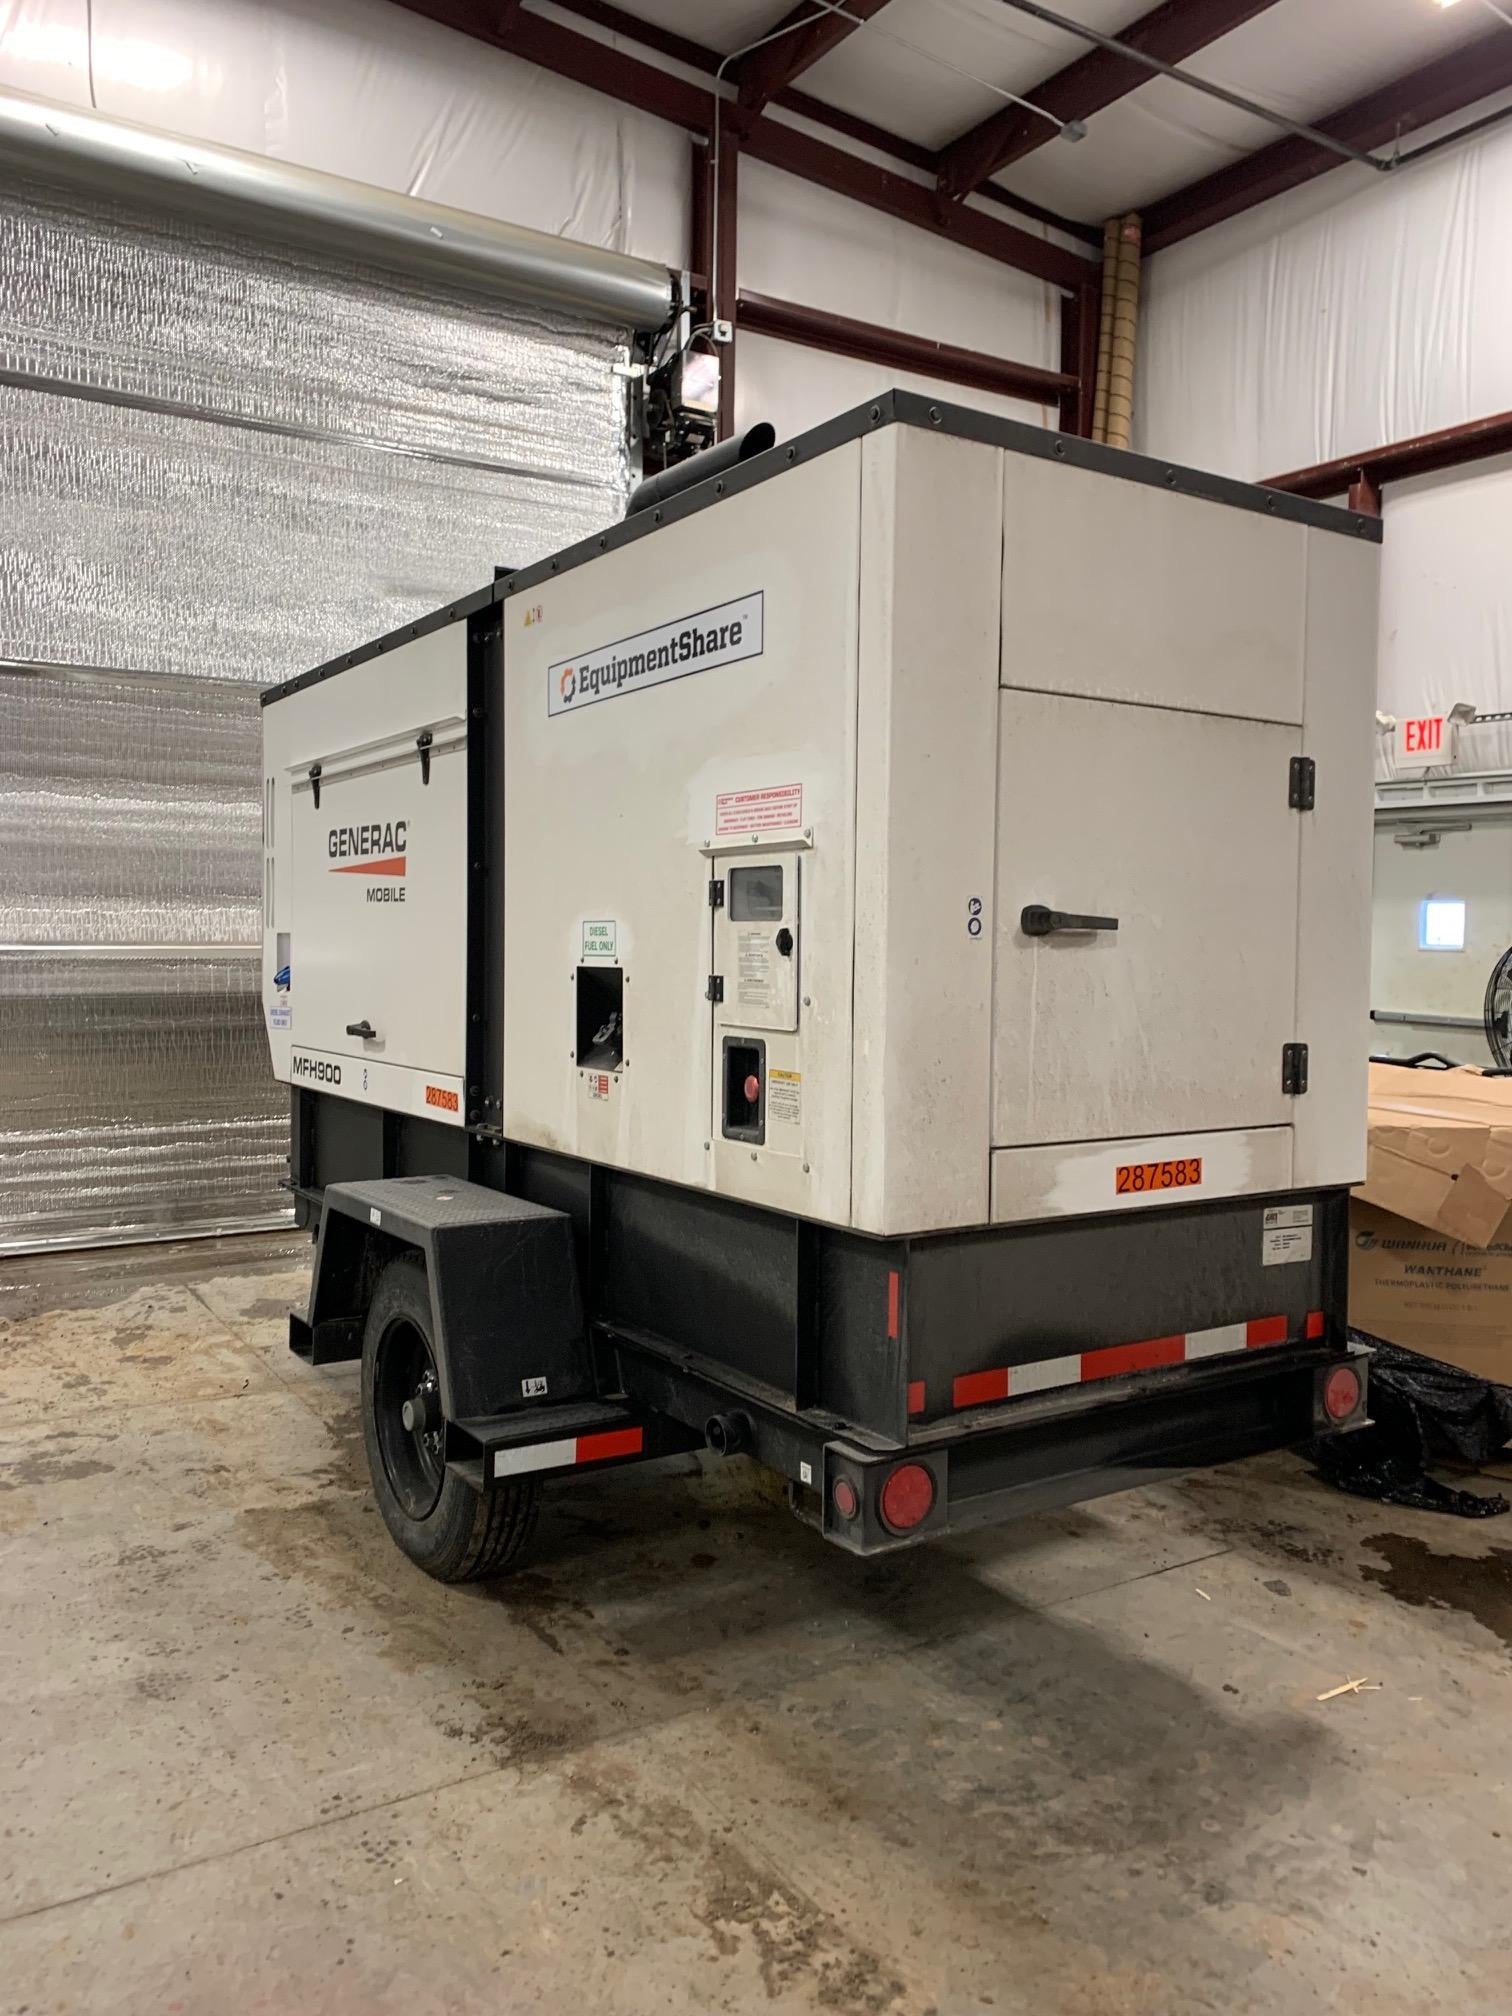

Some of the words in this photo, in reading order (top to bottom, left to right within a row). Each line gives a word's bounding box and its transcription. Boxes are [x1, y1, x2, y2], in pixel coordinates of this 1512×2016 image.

[579, 621, 742, 695] EquipmentShare
[1406, 719, 1443, 752] EXIT
[735, 794, 760, 803] CUSTOMER
[328, 820, 407, 858] GENERAC
[366, 887, 406, 902] MOBILE
[589, 926, 608, 936] DIESEL
[584, 941, 598, 951] FUEL
[599, 940, 614, 951] ONLY
[293, 1055, 342, 1085] MFH900
[426, 1086, 459, 1111] 287583
[1118, 1159, 1201, 1193] 287583
[1404, 1263, 1482, 1277] WANTHANE
[1375, 1278, 1443, 1290] THERMOPLASTIC
